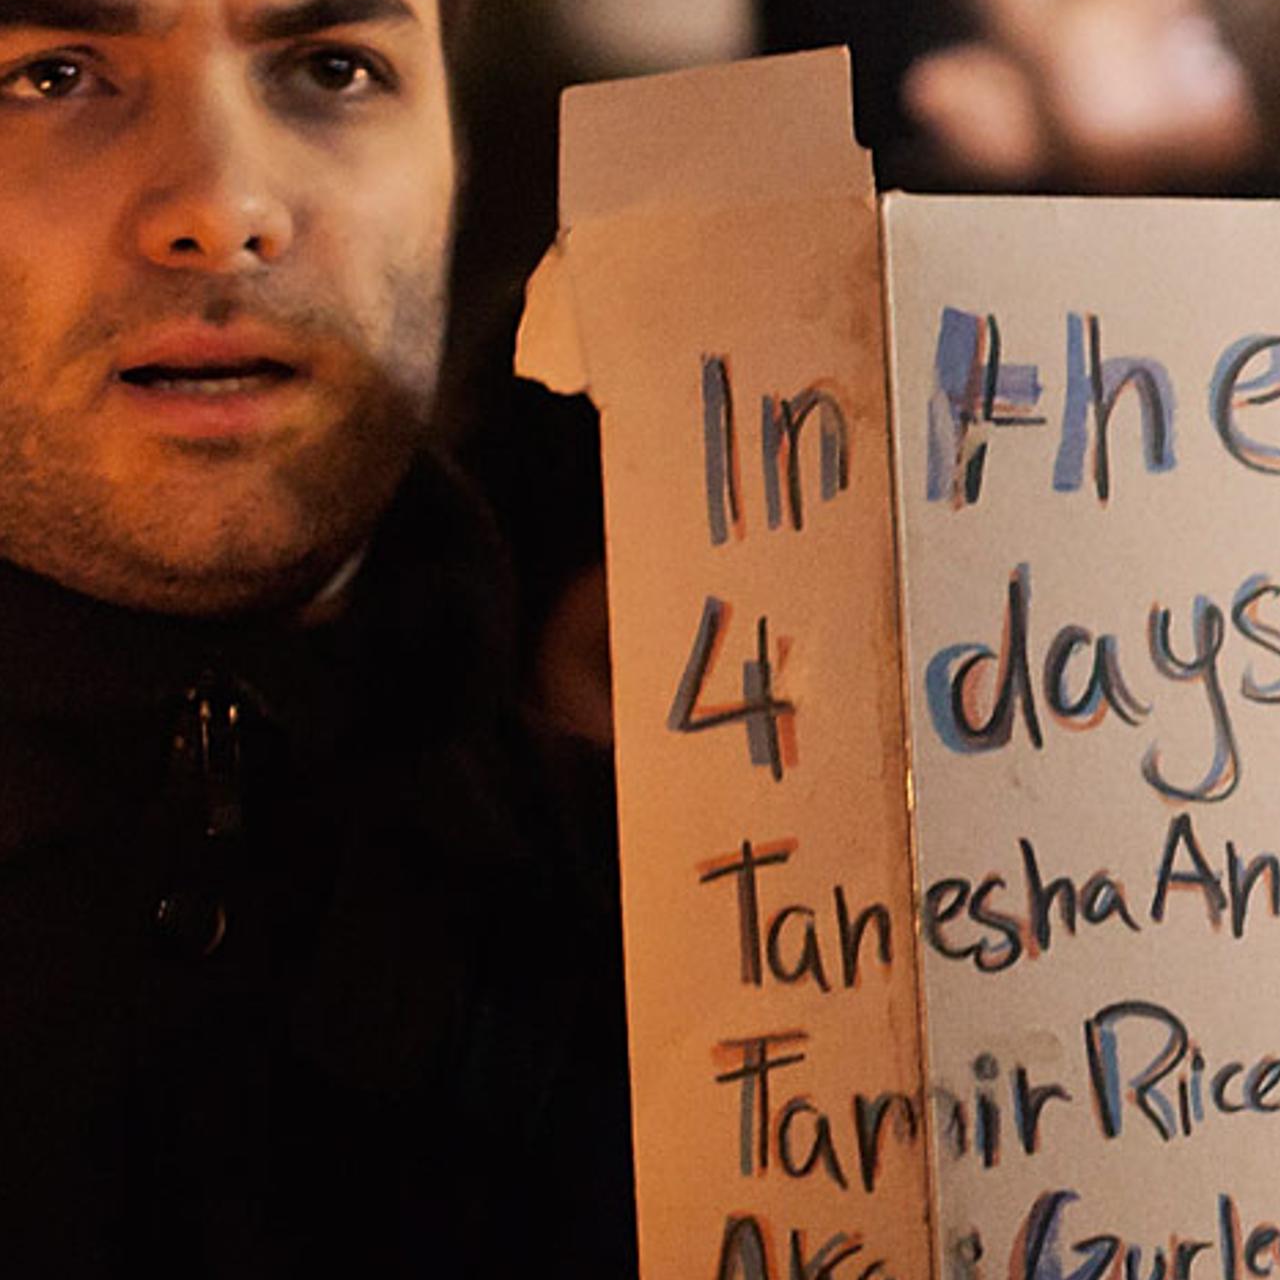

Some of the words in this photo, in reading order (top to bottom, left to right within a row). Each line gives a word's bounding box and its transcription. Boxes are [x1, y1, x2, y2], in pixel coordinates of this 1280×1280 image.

[701, 352, 850, 546] In
[667, 595, 799, 782] 4
[695, 834, 1141, 994] Tanesha
[712, 1029, 1072, 1194] Tamir
